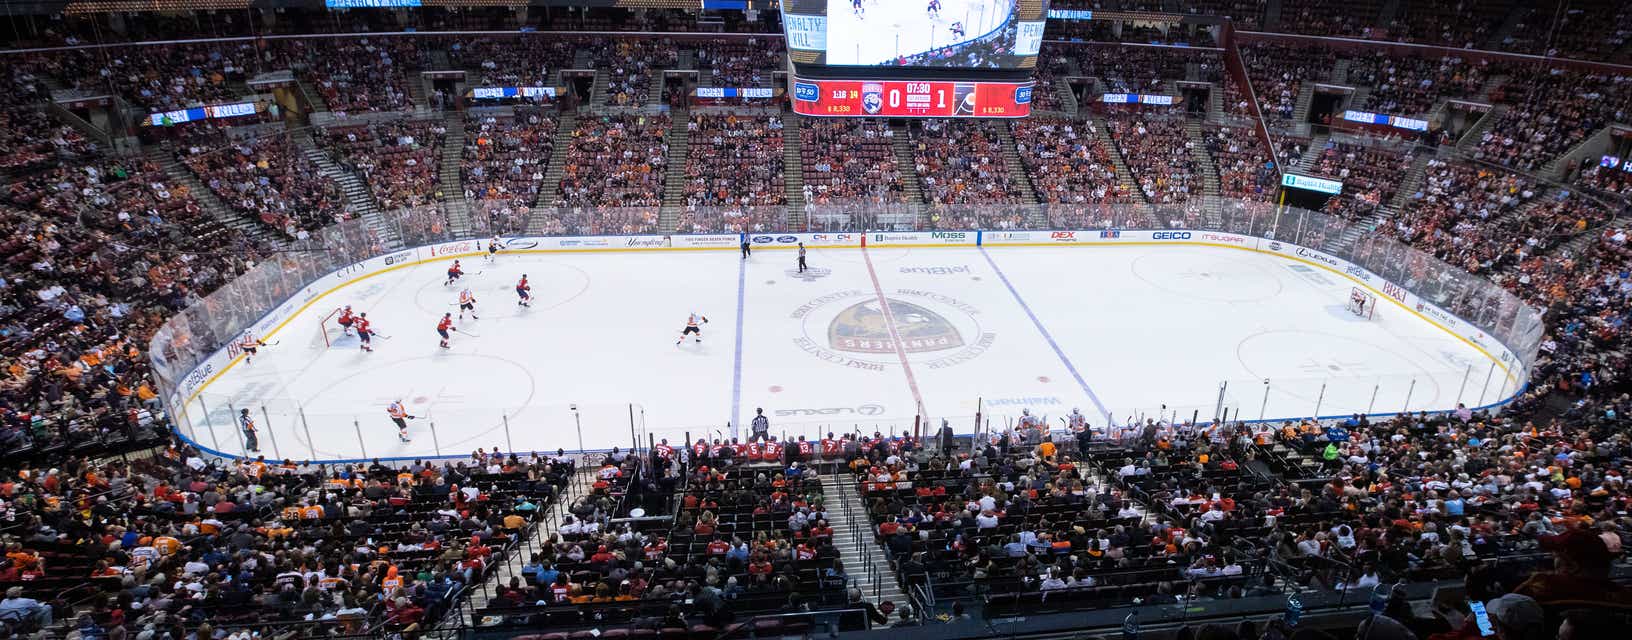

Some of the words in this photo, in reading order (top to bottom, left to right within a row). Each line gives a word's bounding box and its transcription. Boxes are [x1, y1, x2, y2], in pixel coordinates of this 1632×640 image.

[792, 32, 811, 47] KILL
[906, 83, 931, 94] 07:30
[889, 89, 900, 108] 0
[937, 89, 946, 108] 1
[1152, 231, 1191, 239] GEICO
[1309, 253, 1337, 266] LEXUS
